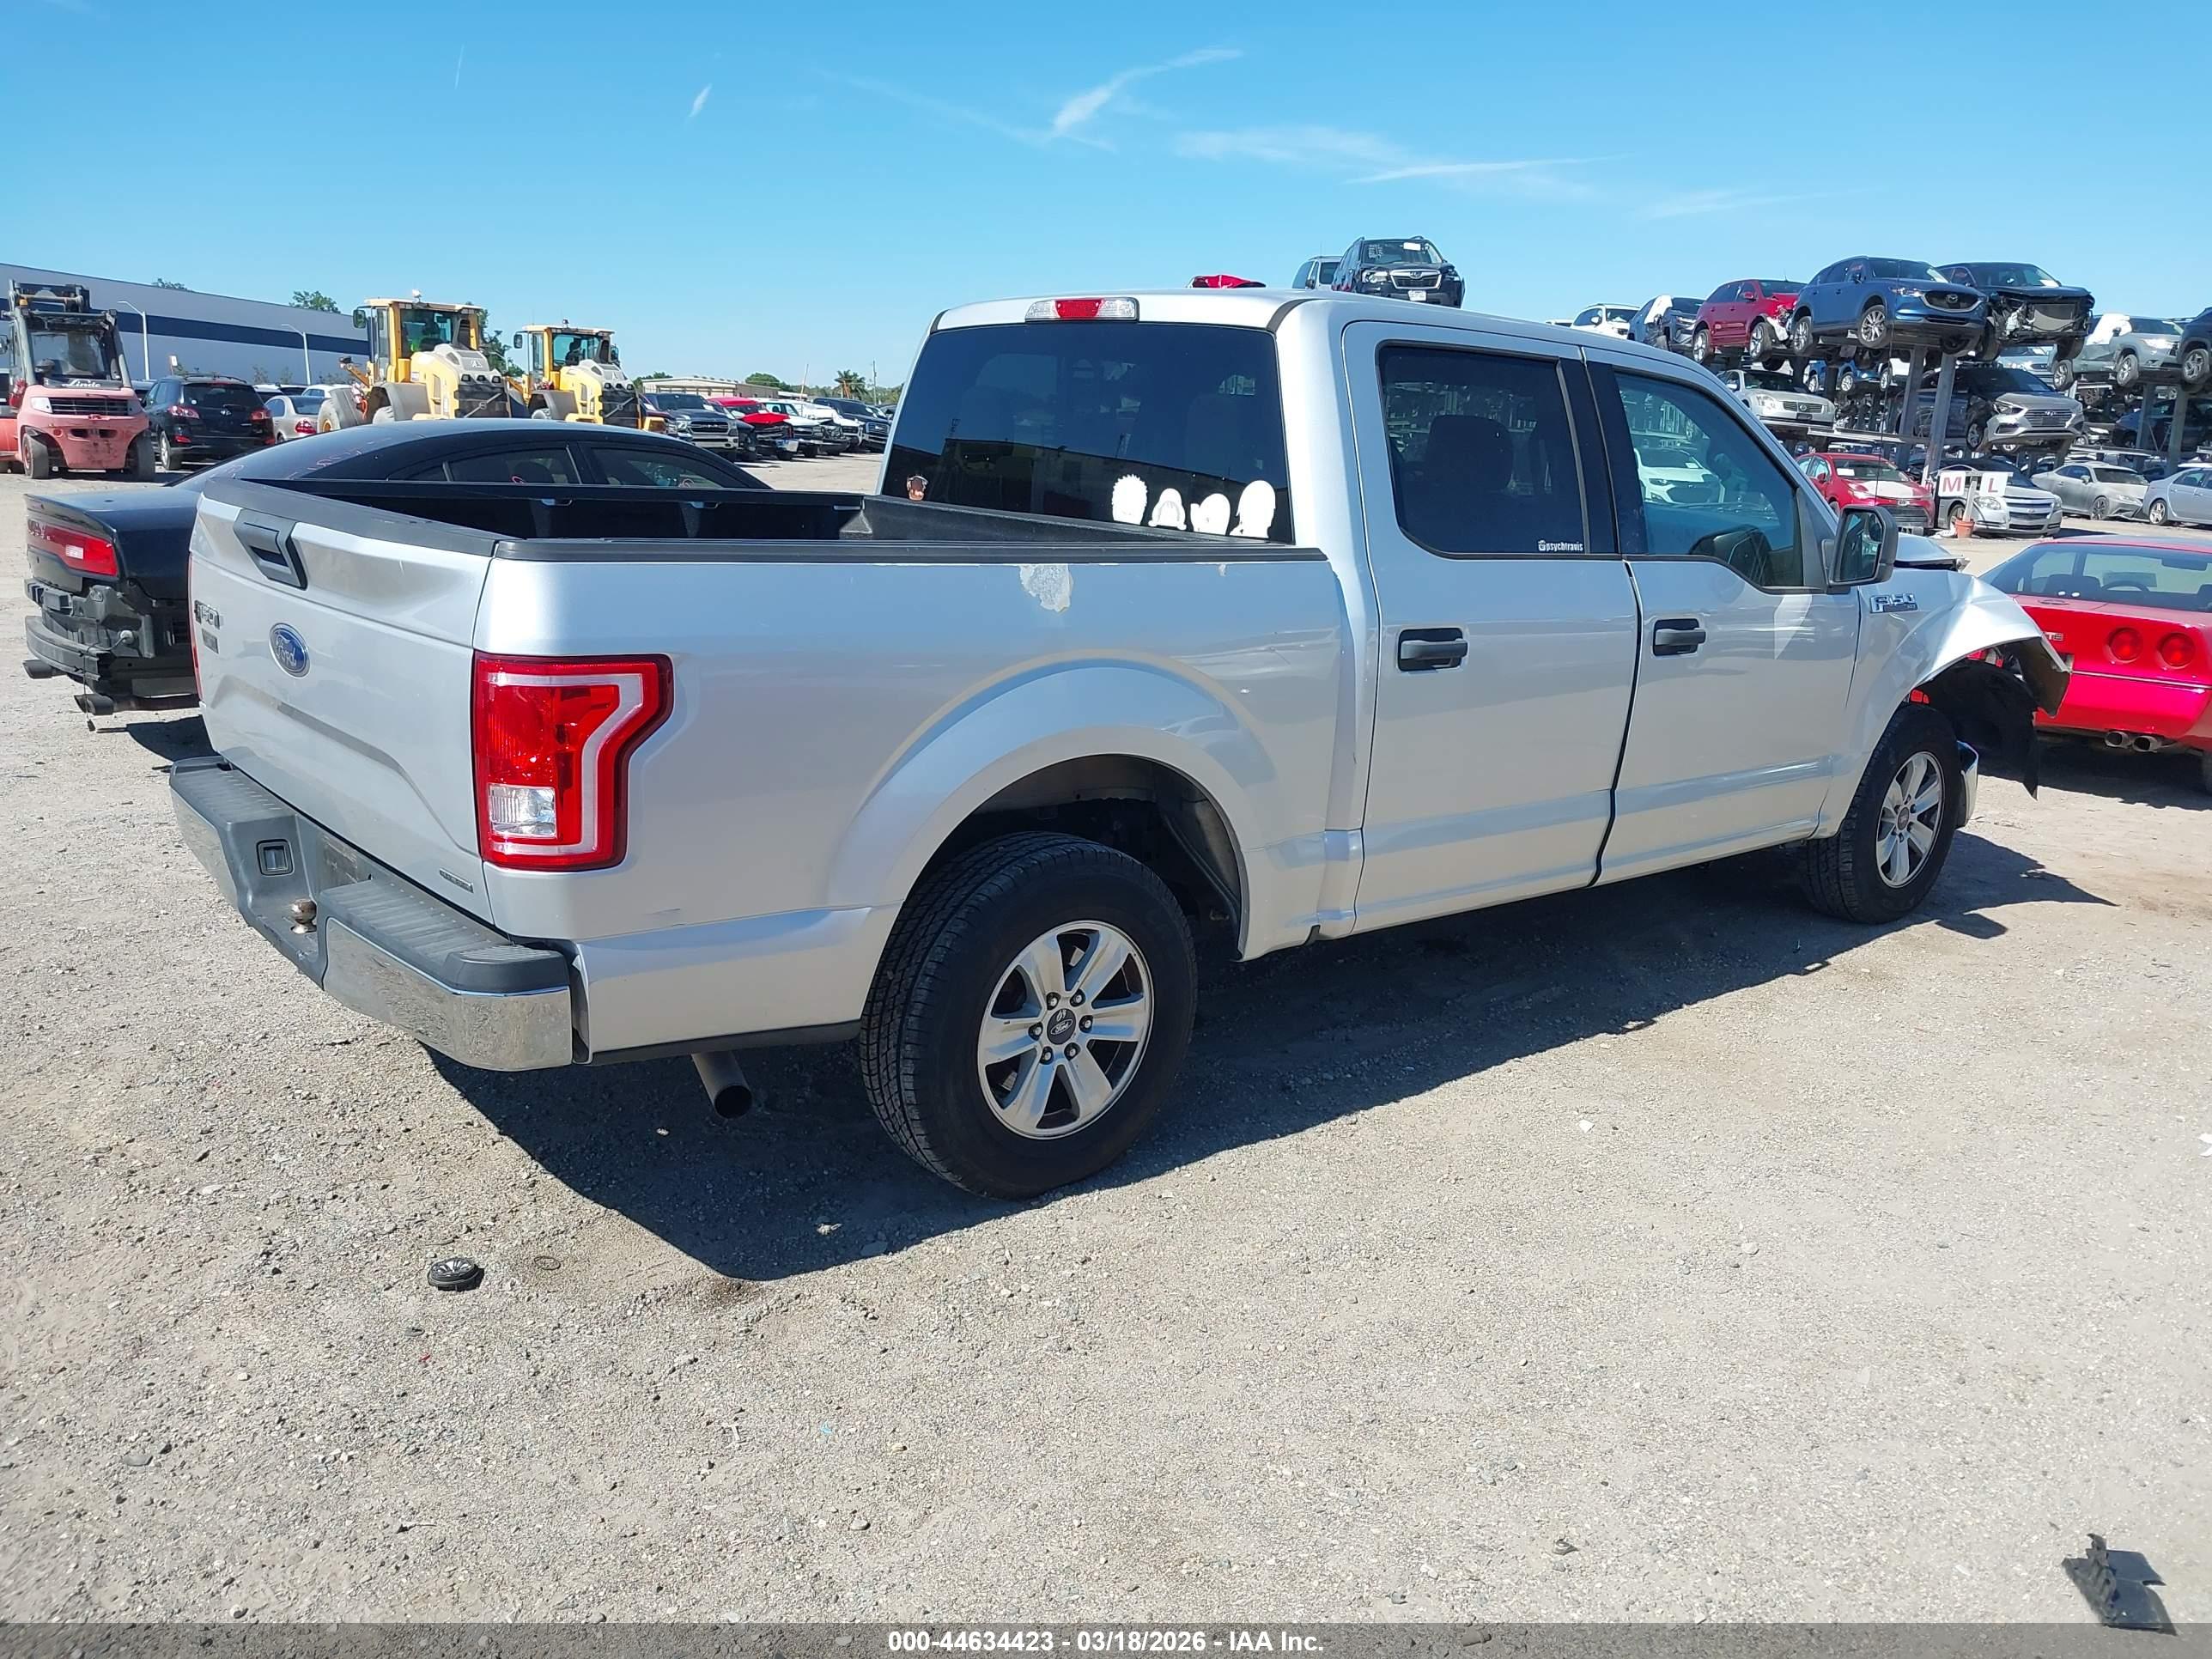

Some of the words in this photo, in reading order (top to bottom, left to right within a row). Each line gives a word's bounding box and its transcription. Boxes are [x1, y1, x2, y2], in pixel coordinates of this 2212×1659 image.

[61, 379, 101, 388] Linde
[1942, 476, 1962, 493] M
[1988, 477, 1998, 493] L
[275, 634, 297, 667] Ford
